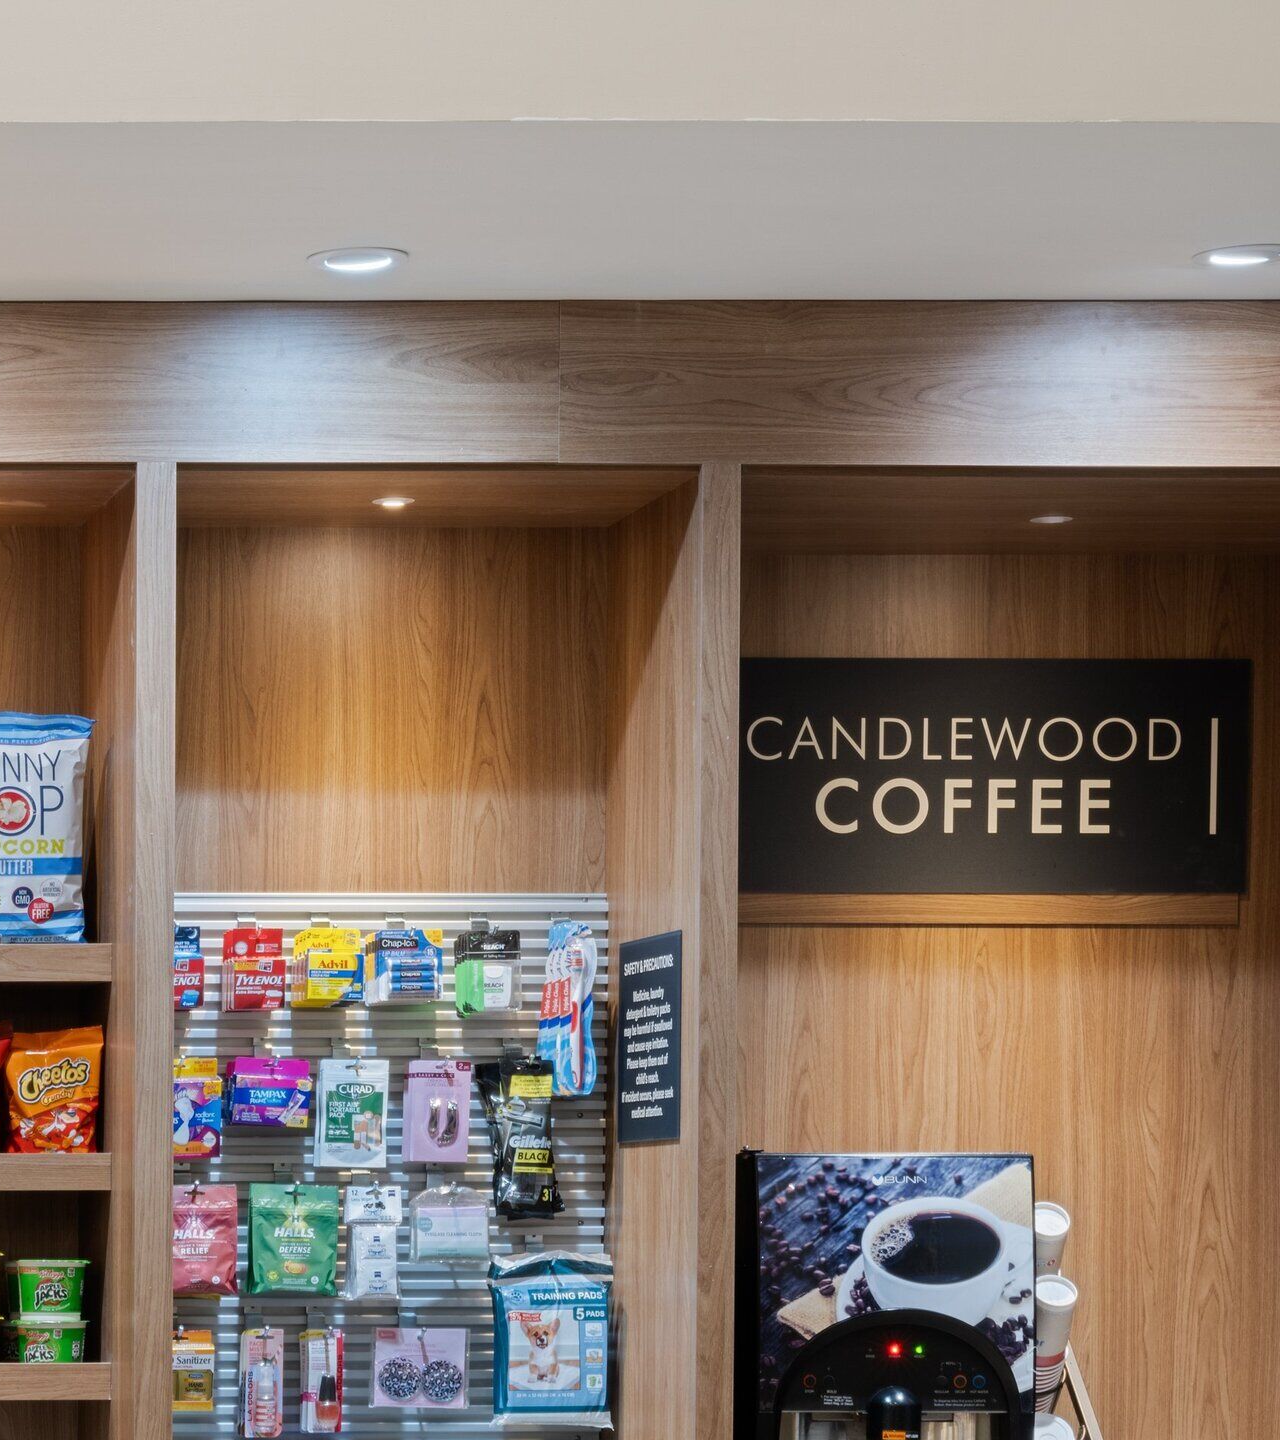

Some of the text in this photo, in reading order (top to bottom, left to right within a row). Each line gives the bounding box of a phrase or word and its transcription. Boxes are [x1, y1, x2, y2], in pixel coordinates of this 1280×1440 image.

[745, 715, 1183, 762] CANDLEWOOD
[814, 777, 1111, 835] COFFEE
[15, 895, 31, 905] GMO
[31, 908, 51, 919] FREE
[318, 959, 349, 969] Advil
[624, 960, 640, 976] SAFETY
[643, 953, 674, 973] PRECAUTIONS:
[235, 974, 283, 986] TYLENOL
[627, 1058, 639, 1070] Please
[18, 1057, 90, 1103] Cheetos
[249, 1089, 287, 1099] TAMPAX
[338, 1084, 373, 1094] CURAD
[41, 1088, 76, 1106] Crunchy
[517, 1151, 548, 1162] BLACK
[884, 1174, 927, 1184] BUNN
[180, 1247, 209, 1255] RELIEF
[279, 1246, 312, 1254] DEFENSE
[34, 1289, 68, 1309] JACKS
[530, 1291, 603, 1301] TRAINING PADS
[575, 1307, 605, 1320] 5 PADS
[176, 1356, 211, 1365] Sanitizer
